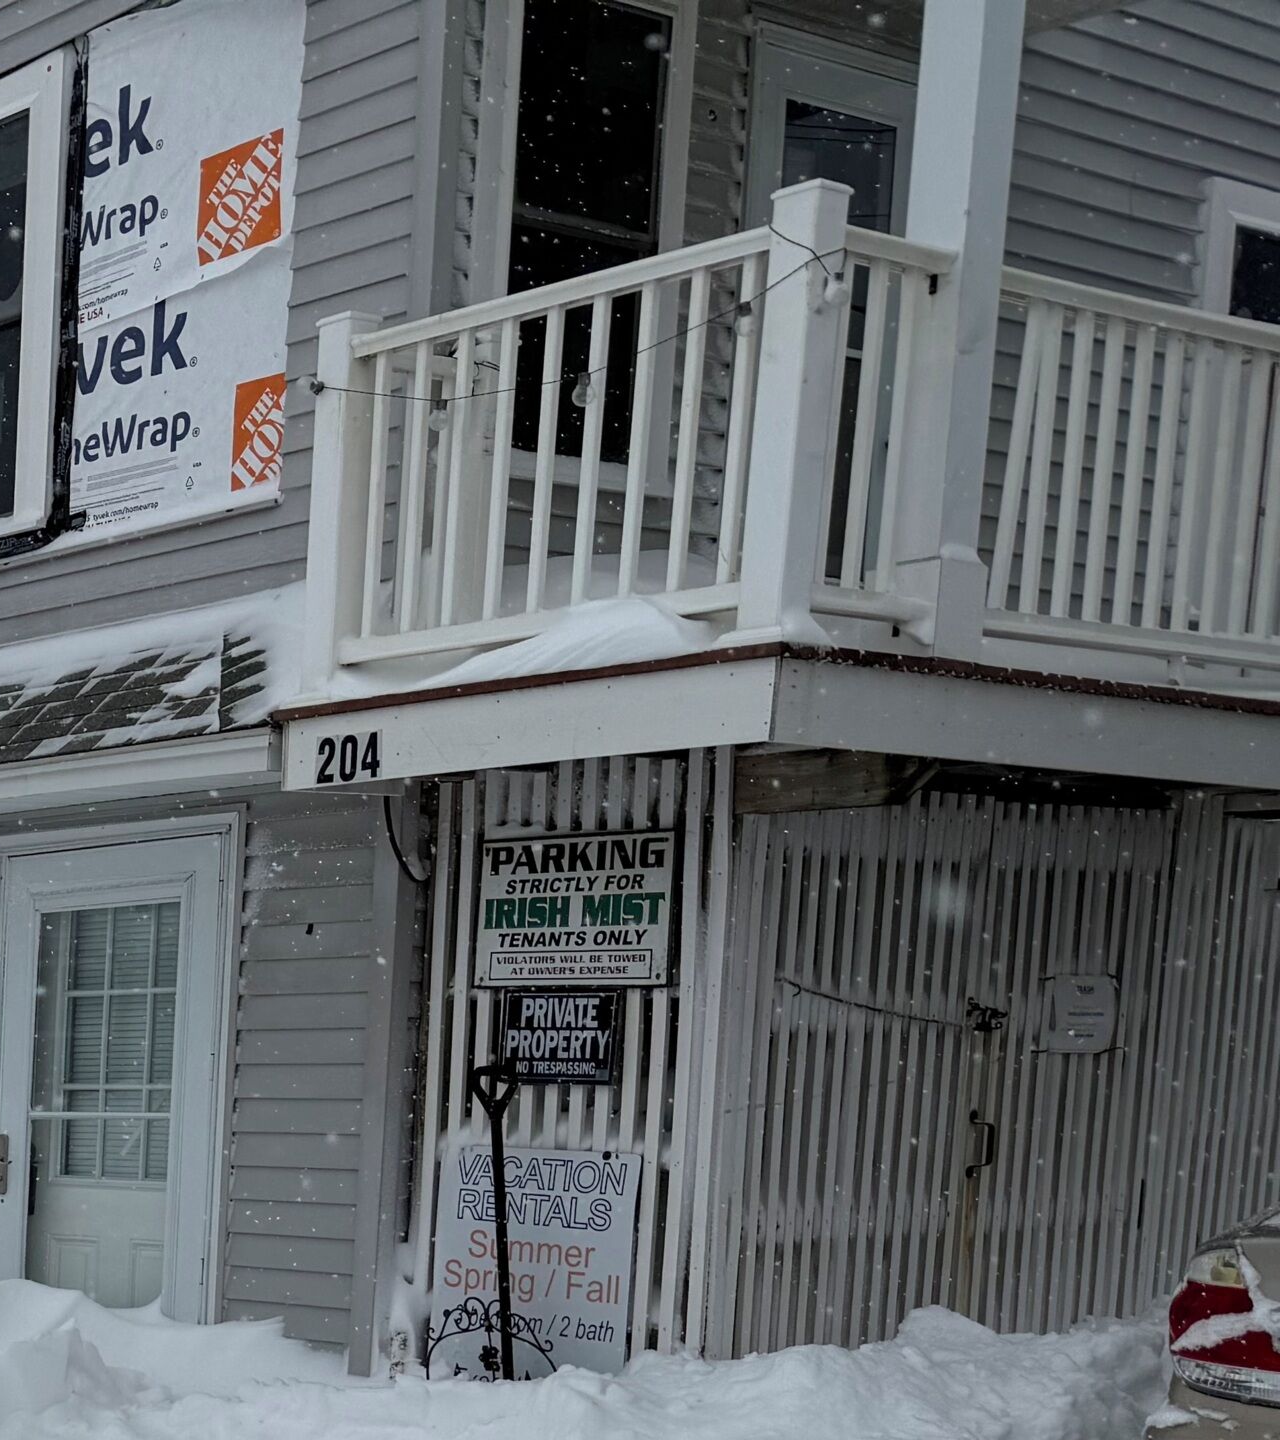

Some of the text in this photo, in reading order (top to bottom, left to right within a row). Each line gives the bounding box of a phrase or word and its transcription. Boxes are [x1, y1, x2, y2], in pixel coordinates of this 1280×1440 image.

[197, 133, 282, 261] HOME
[206, 158, 241, 208] THE
[228, 170, 281, 252] DEPOT
[87, 307, 104, 321] USA
[241, 387, 278, 434] THE
[316, 731, 380, 784] 204
[485, 837, 669, 876] PARKING
[505, 874, 645, 895] STRICTLY FOR
[483, 892, 666, 930] IRISH MIST
[498, 929, 648, 948] TENANTS ONLY
[496, 953, 646, 965] VIOLATORS WILL BE TOWED
[510, 965, 629, 976] AT OWNER'S EXPENSE
[520, 998, 600, 1028] PRIVATE
[506, 1029, 610, 1059] PROPERTY
[516, 1061, 596, 1075] NO TRESPASSING
[458, 1153, 628, 1196] VACATION
[457, 1188, 612, 1231] RENTALS
[566, 1271, 620, 1305] Fall
[559, 1315, 571, 1338] 2
[575, 1317, 615, 1343] bath
